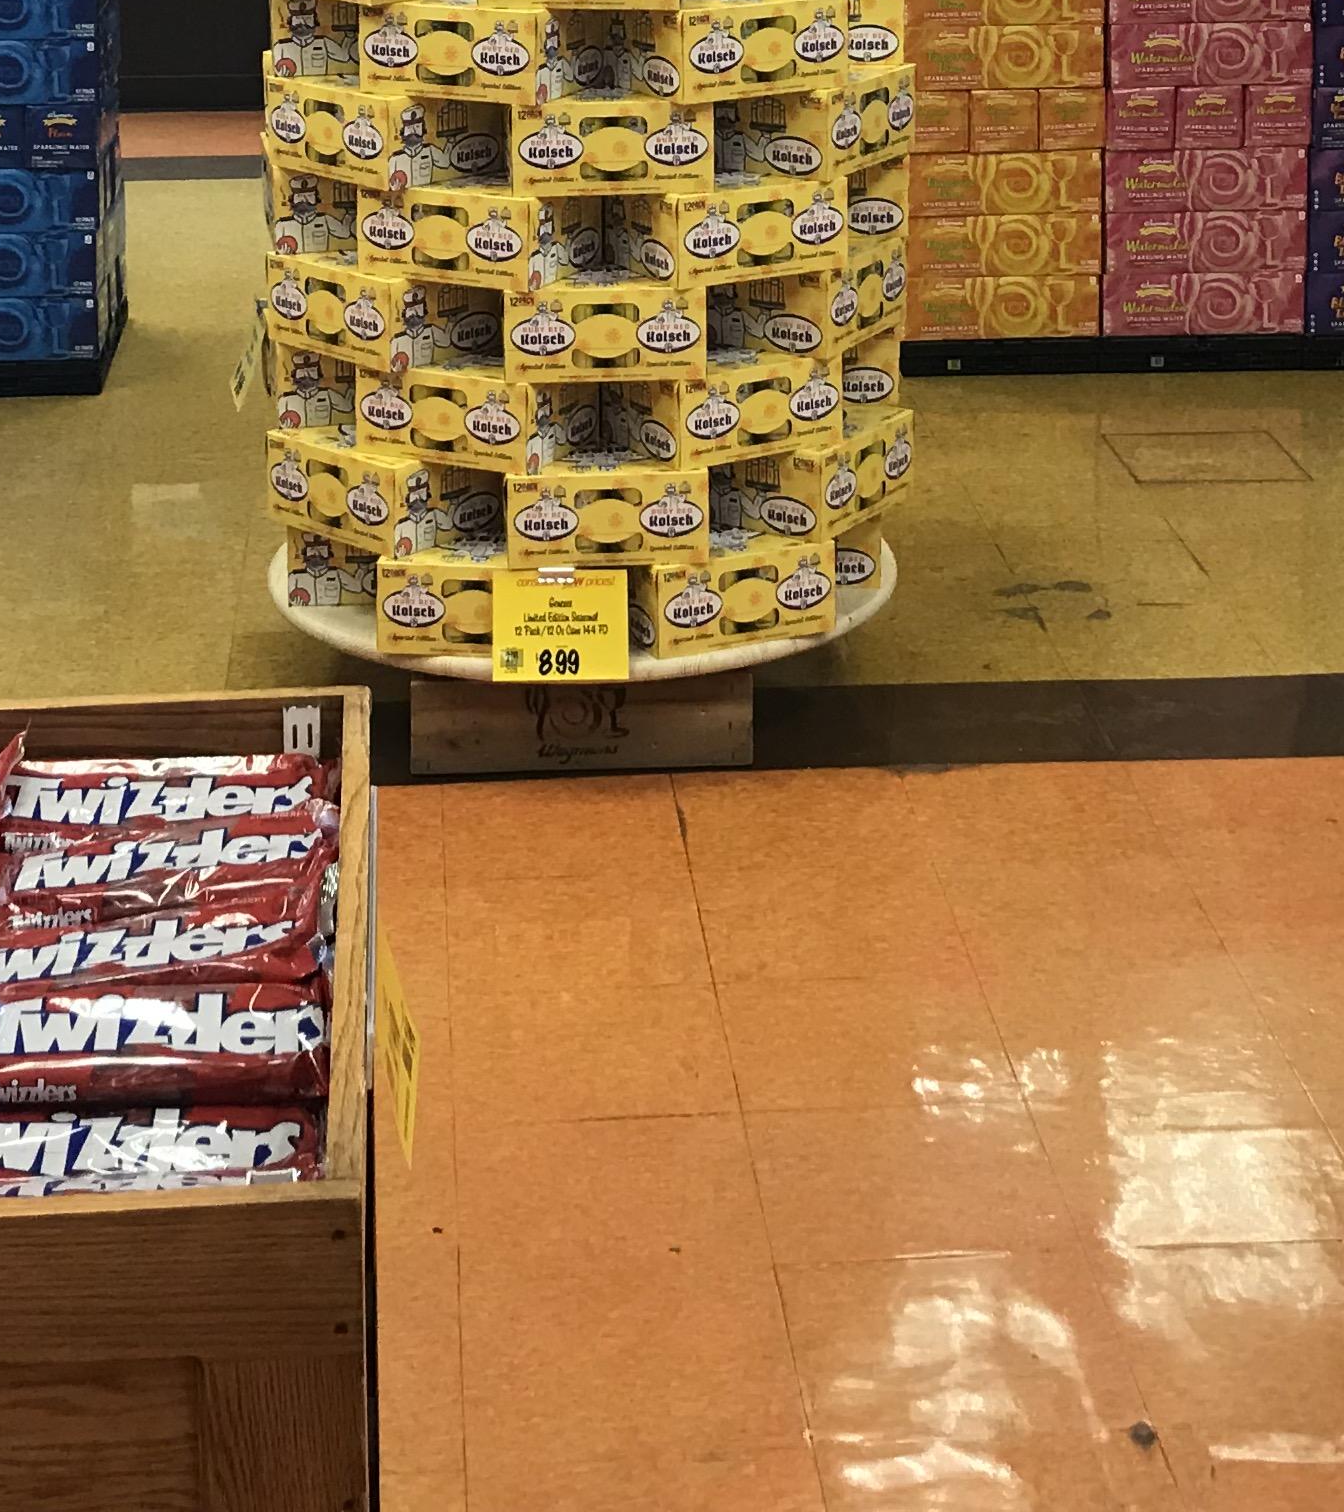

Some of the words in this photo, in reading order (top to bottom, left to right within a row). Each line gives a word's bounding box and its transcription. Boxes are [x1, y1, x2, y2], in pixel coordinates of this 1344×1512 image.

[480, 50, 521, 66] Kolsch
[697, 48, 736, 63] Kolsch
[528, 144, 573, 159] Kolsch
[653, 141, 699, 157] Kolsch
[474, 235, 514, 254] Kolsch
[520, 330, 566, 346] Kolsch
[523, 514, 569, 531] Kolsch
[648, 511, 693, 527] Kolsch
[391, 603, 436, 619] Kolsch
